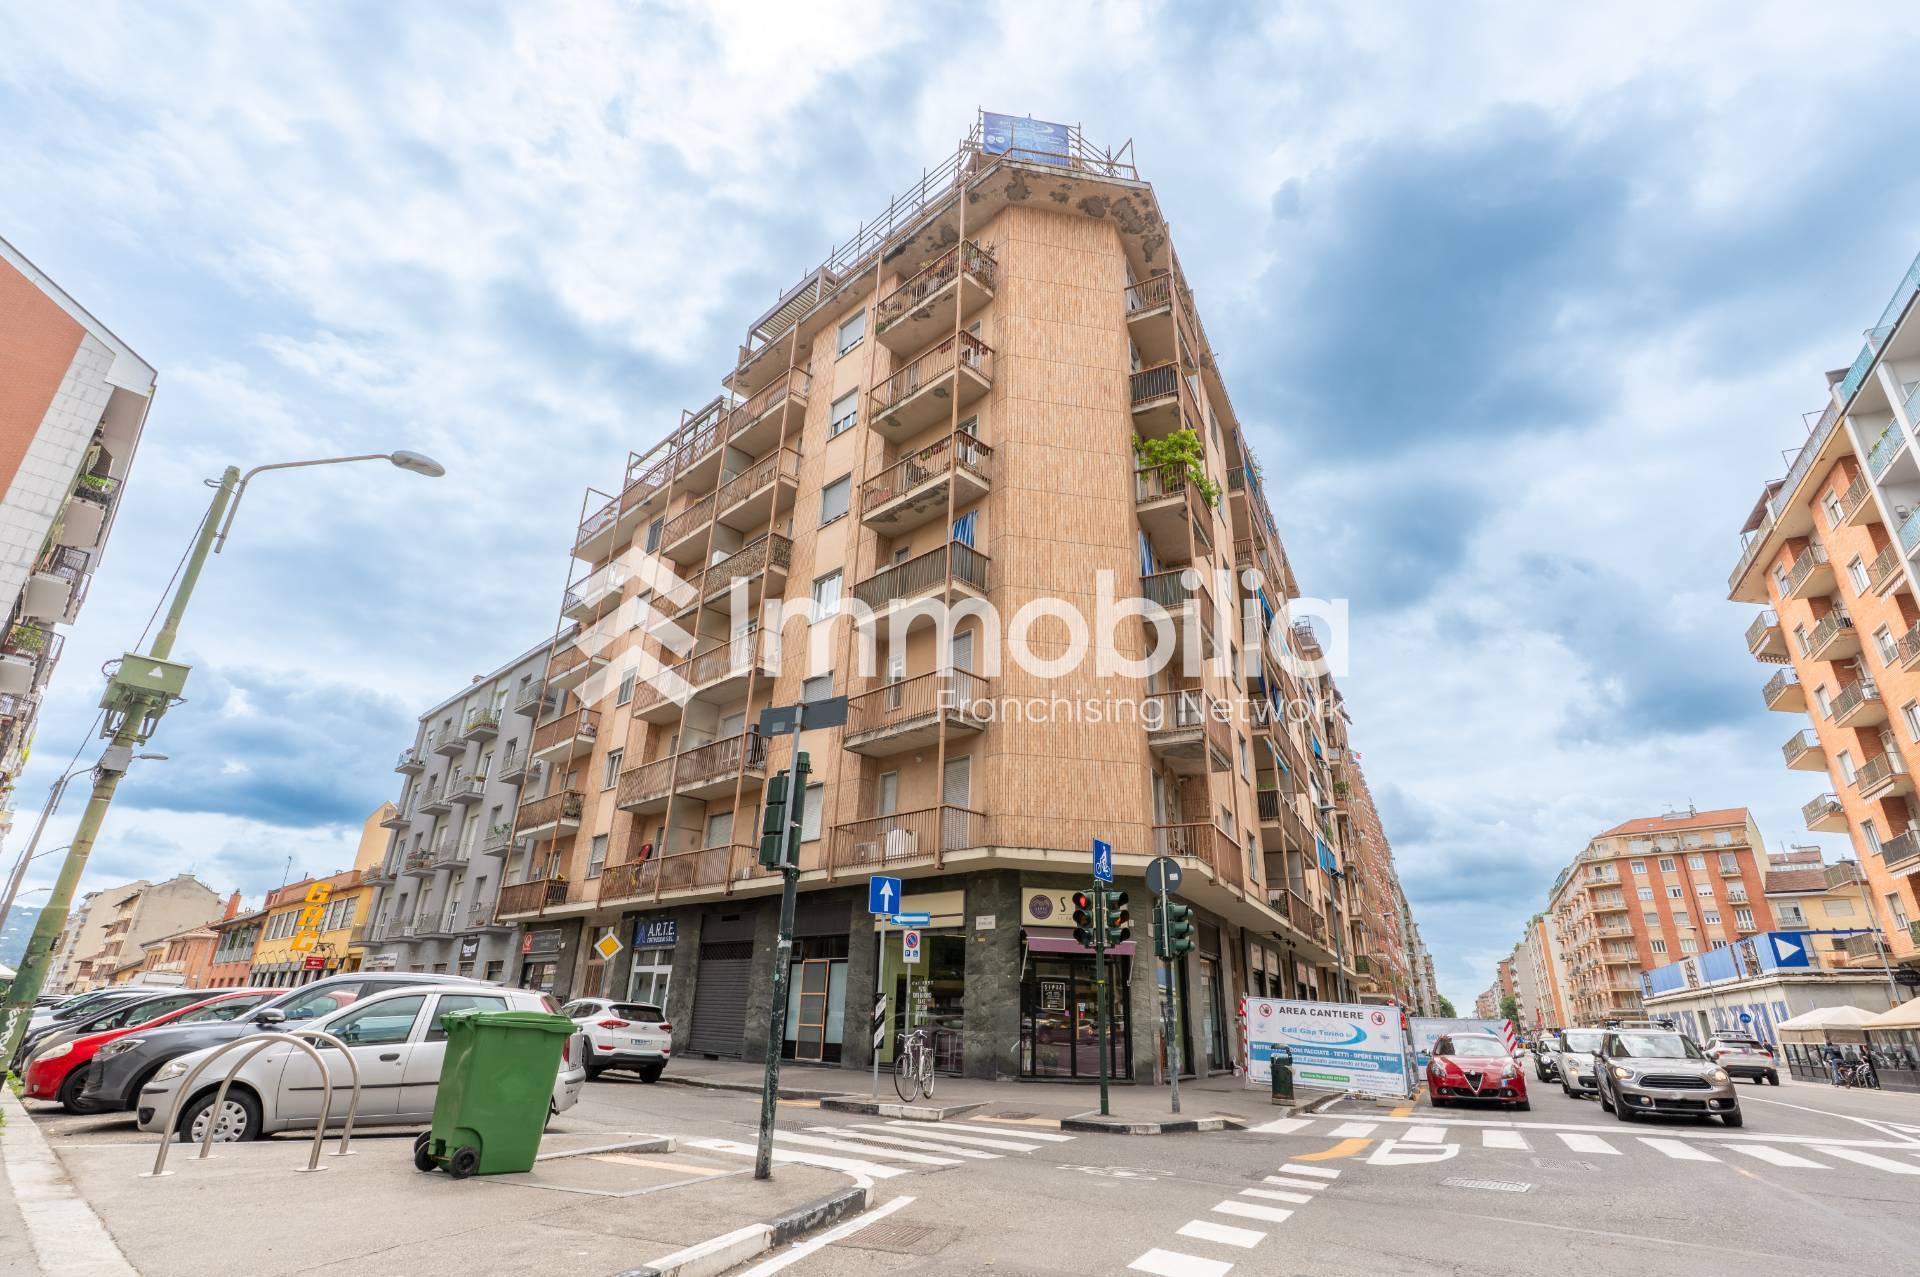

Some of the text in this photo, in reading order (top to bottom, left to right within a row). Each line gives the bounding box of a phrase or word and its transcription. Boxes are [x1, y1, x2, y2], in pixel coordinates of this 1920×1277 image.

[1279, 1006, 1364, 1020] AREA CANTIERE
[1300, 1028, 1316, 1036] Gap
[1319, 1030, 1344, 1038] Torino
